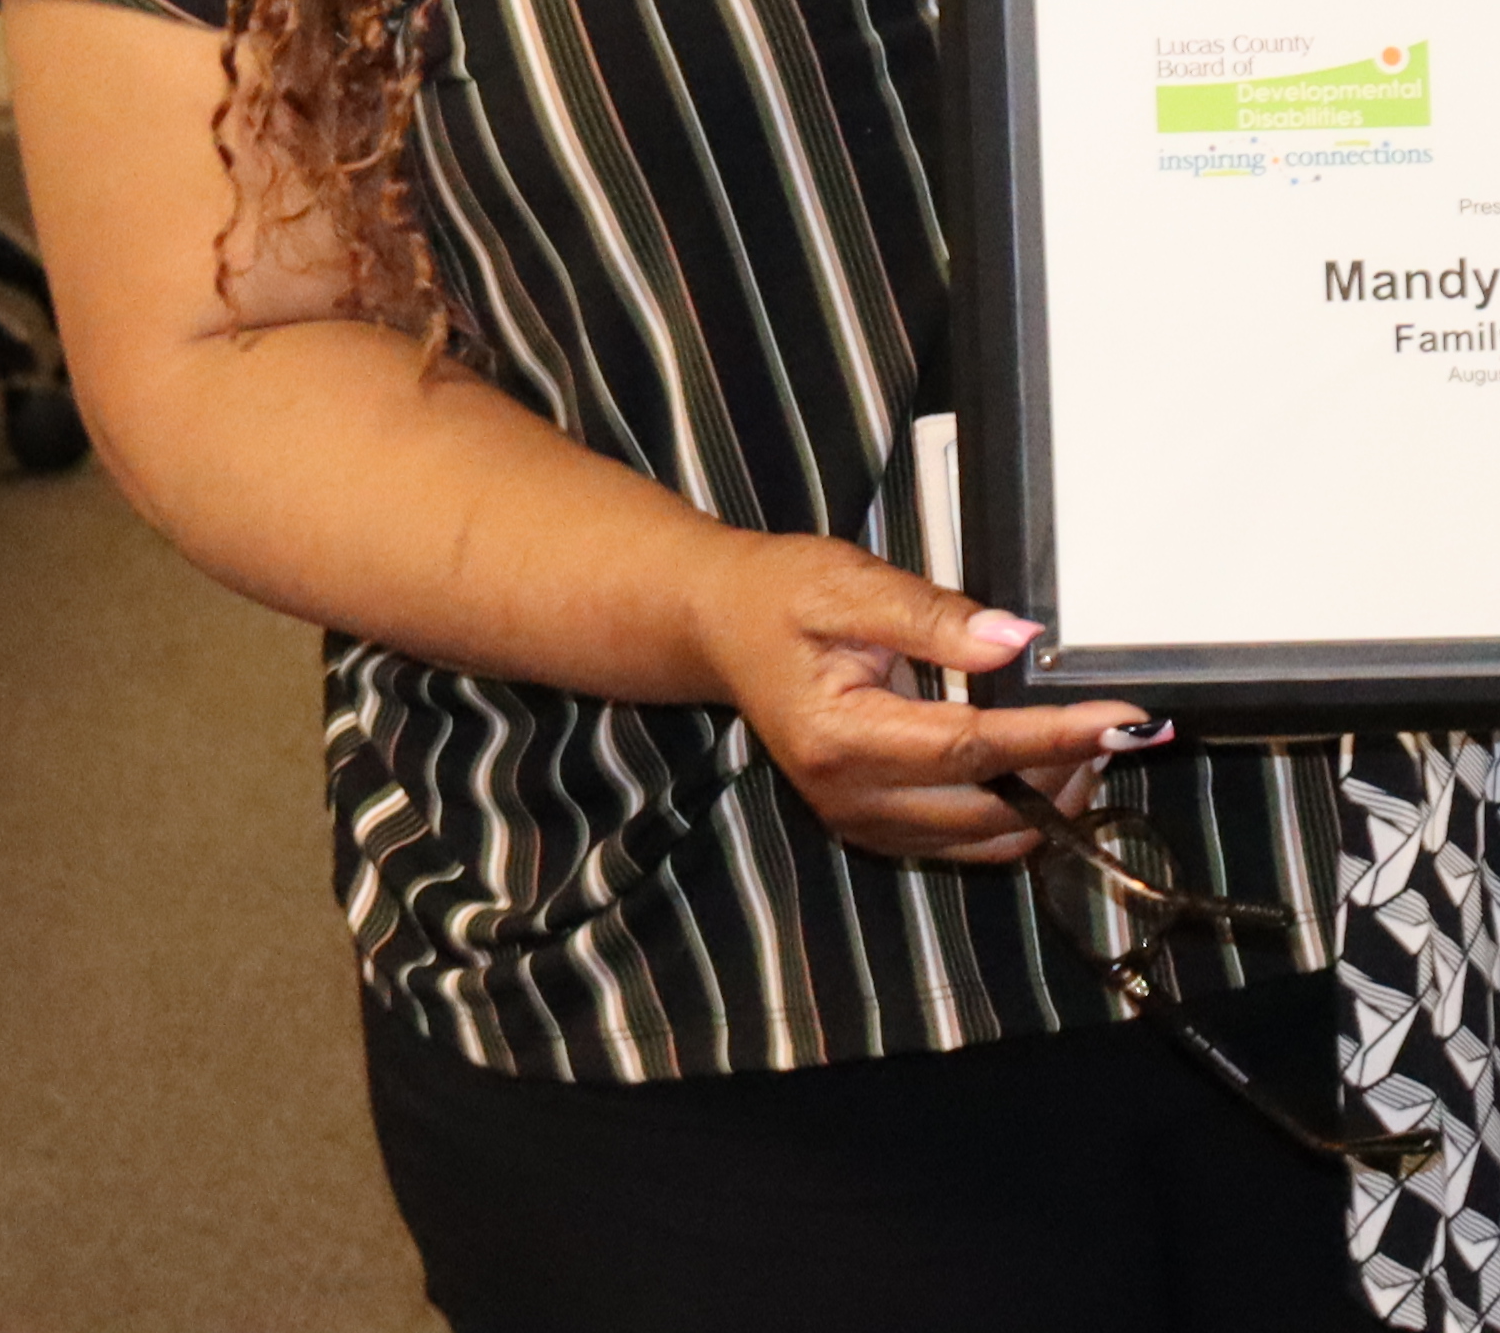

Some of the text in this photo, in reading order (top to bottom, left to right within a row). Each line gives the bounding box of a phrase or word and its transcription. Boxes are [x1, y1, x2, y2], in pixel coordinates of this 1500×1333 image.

[1155, 34, 1314, 57] Lucas County
[1156, 56, 1255, 79] Board of
[1236, 78, 1423, 104] Developmental
[1237, 106, 1364, 130] Disabilities
[1158, 141, 1434, 177] inspiring connections
[1323, 257, 1500, 310] Mandy
